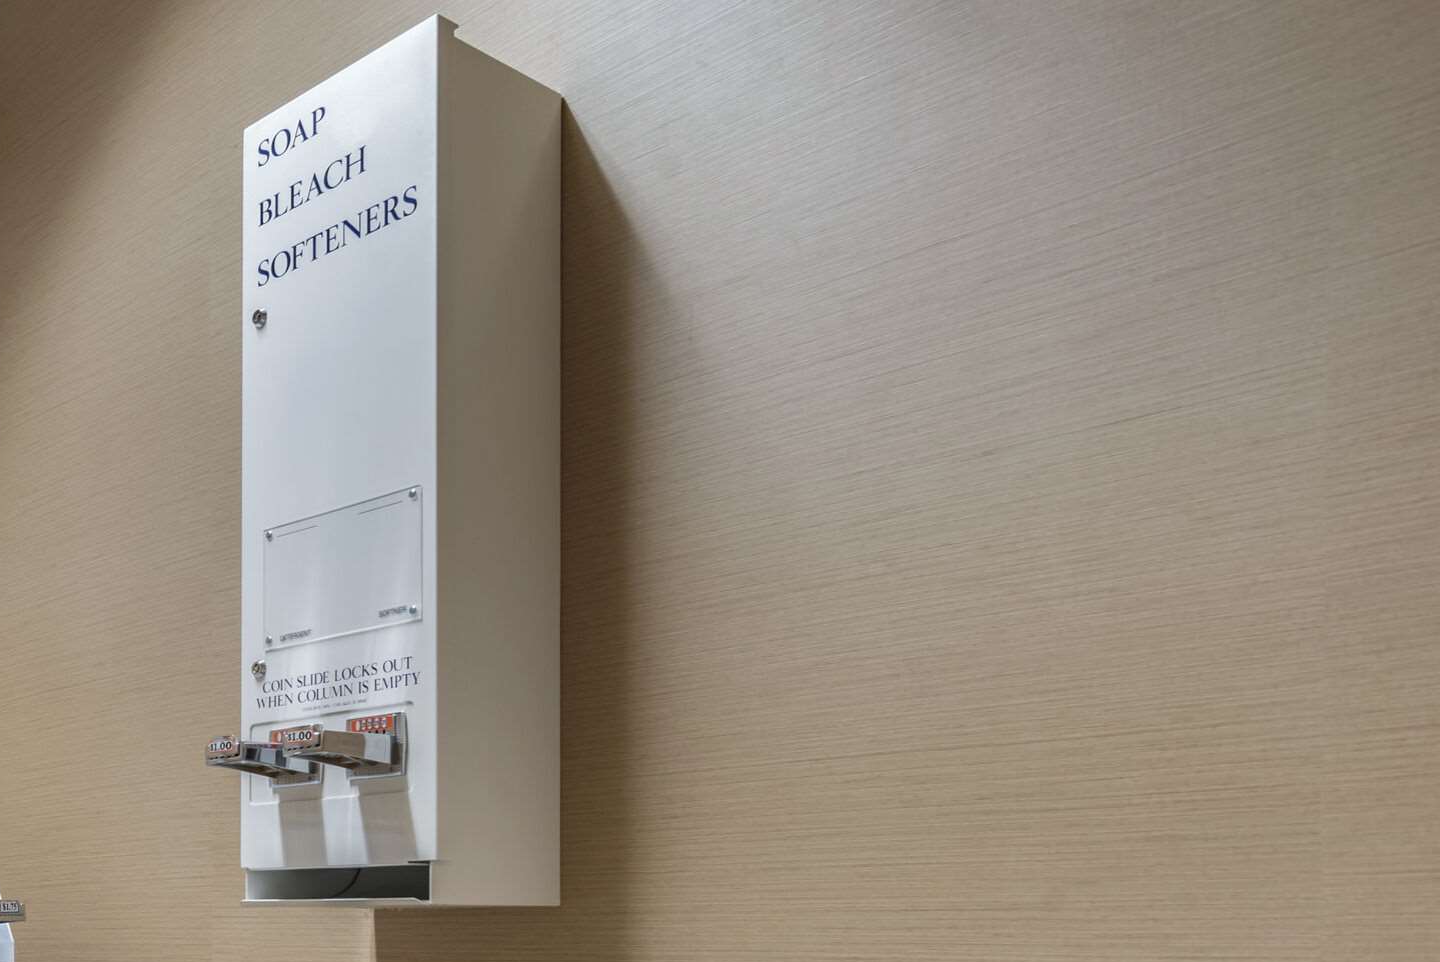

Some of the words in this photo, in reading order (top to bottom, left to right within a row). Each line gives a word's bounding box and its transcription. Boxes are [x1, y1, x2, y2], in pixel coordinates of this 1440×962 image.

[257, 106, 327, 167] SOAP
[258, 144, 367, 227] BLEACH
[257, 185, 419, 287] SOFTENERS
[256, 693, 294, 710] WHEN
[297, 684, 354, 702] COLUMN
[359, 681, 369, 695] IS
[374, 671, 421, 692] EMPTY
[262, 678, 293, 694] COIN
[296, 670, 330, 689] SLIDE
[334, 662, 379, 682] LOCKS
[382, 656, 413, 673] OUT
